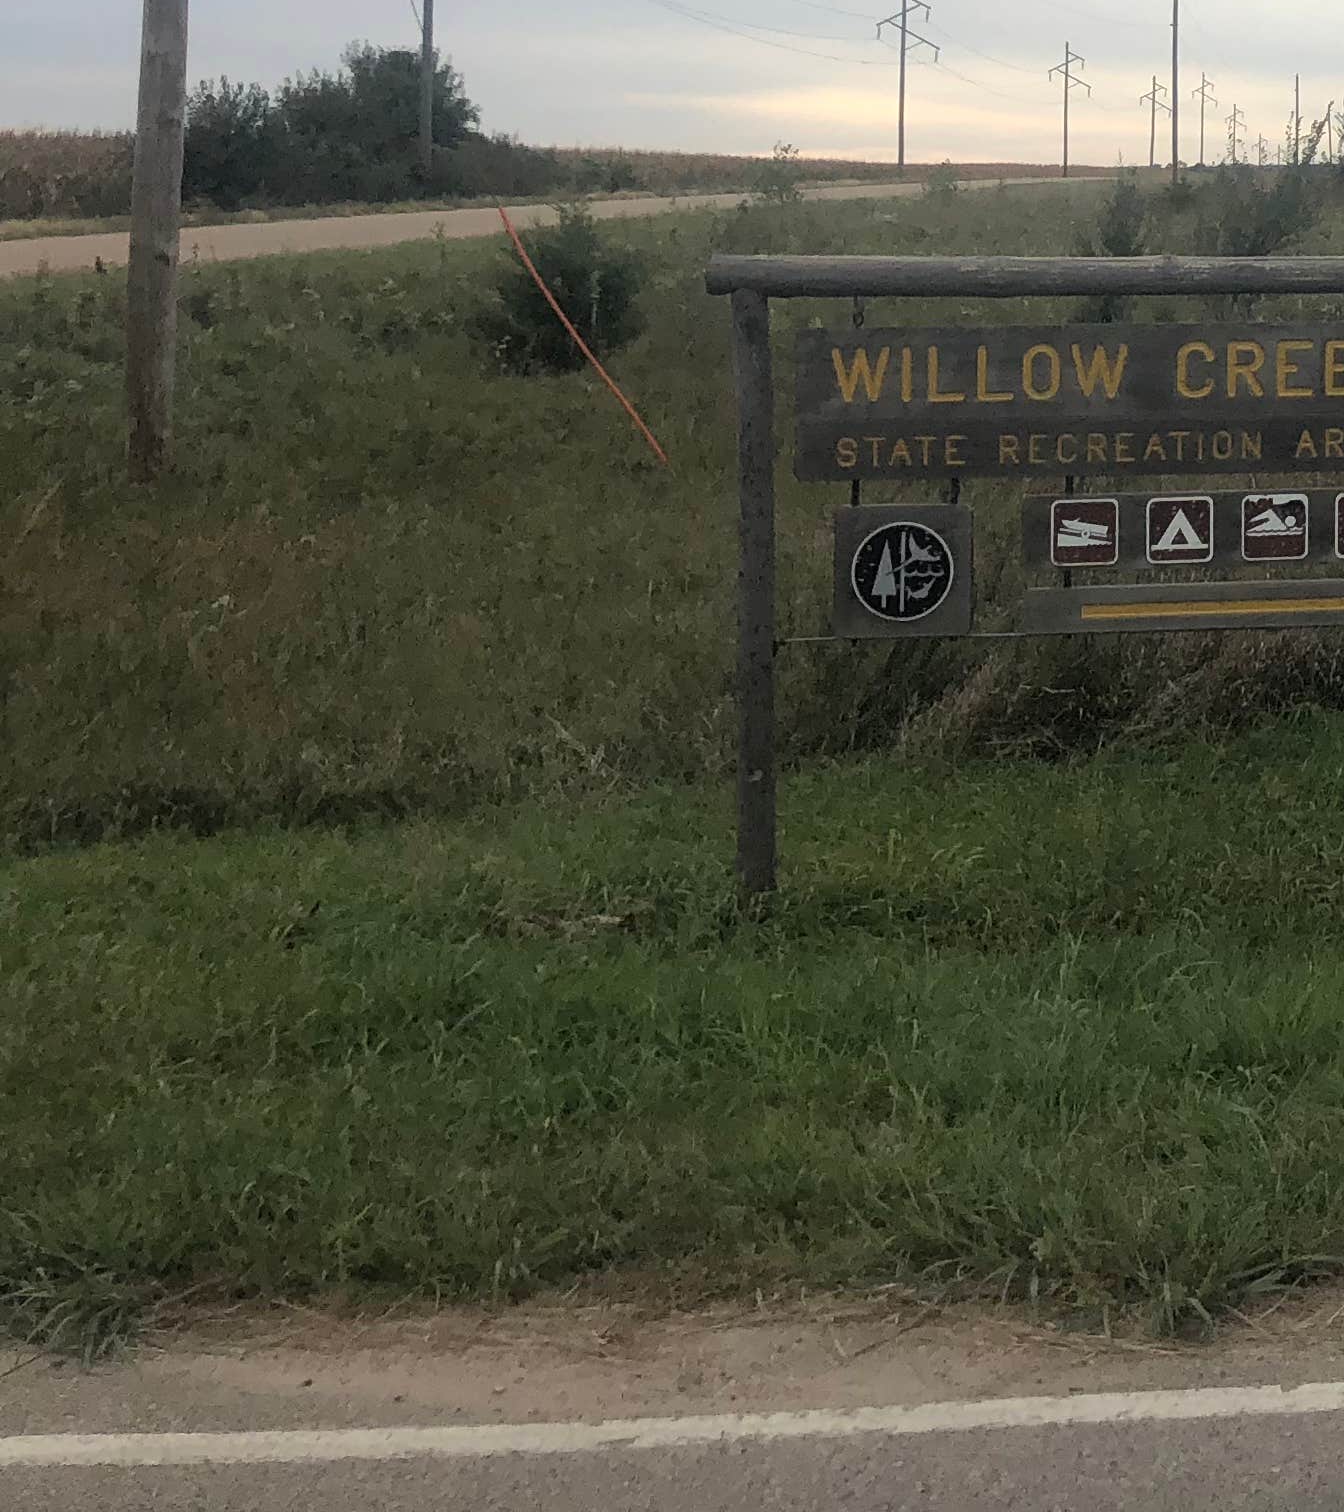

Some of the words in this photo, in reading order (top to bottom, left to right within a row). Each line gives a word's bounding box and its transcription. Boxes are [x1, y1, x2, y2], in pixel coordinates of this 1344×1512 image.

[831, 343, 1128, 403] WILLOW
[836, 435, 967, 468] STATE
[999, 430, 1263, 465] RECREATION
